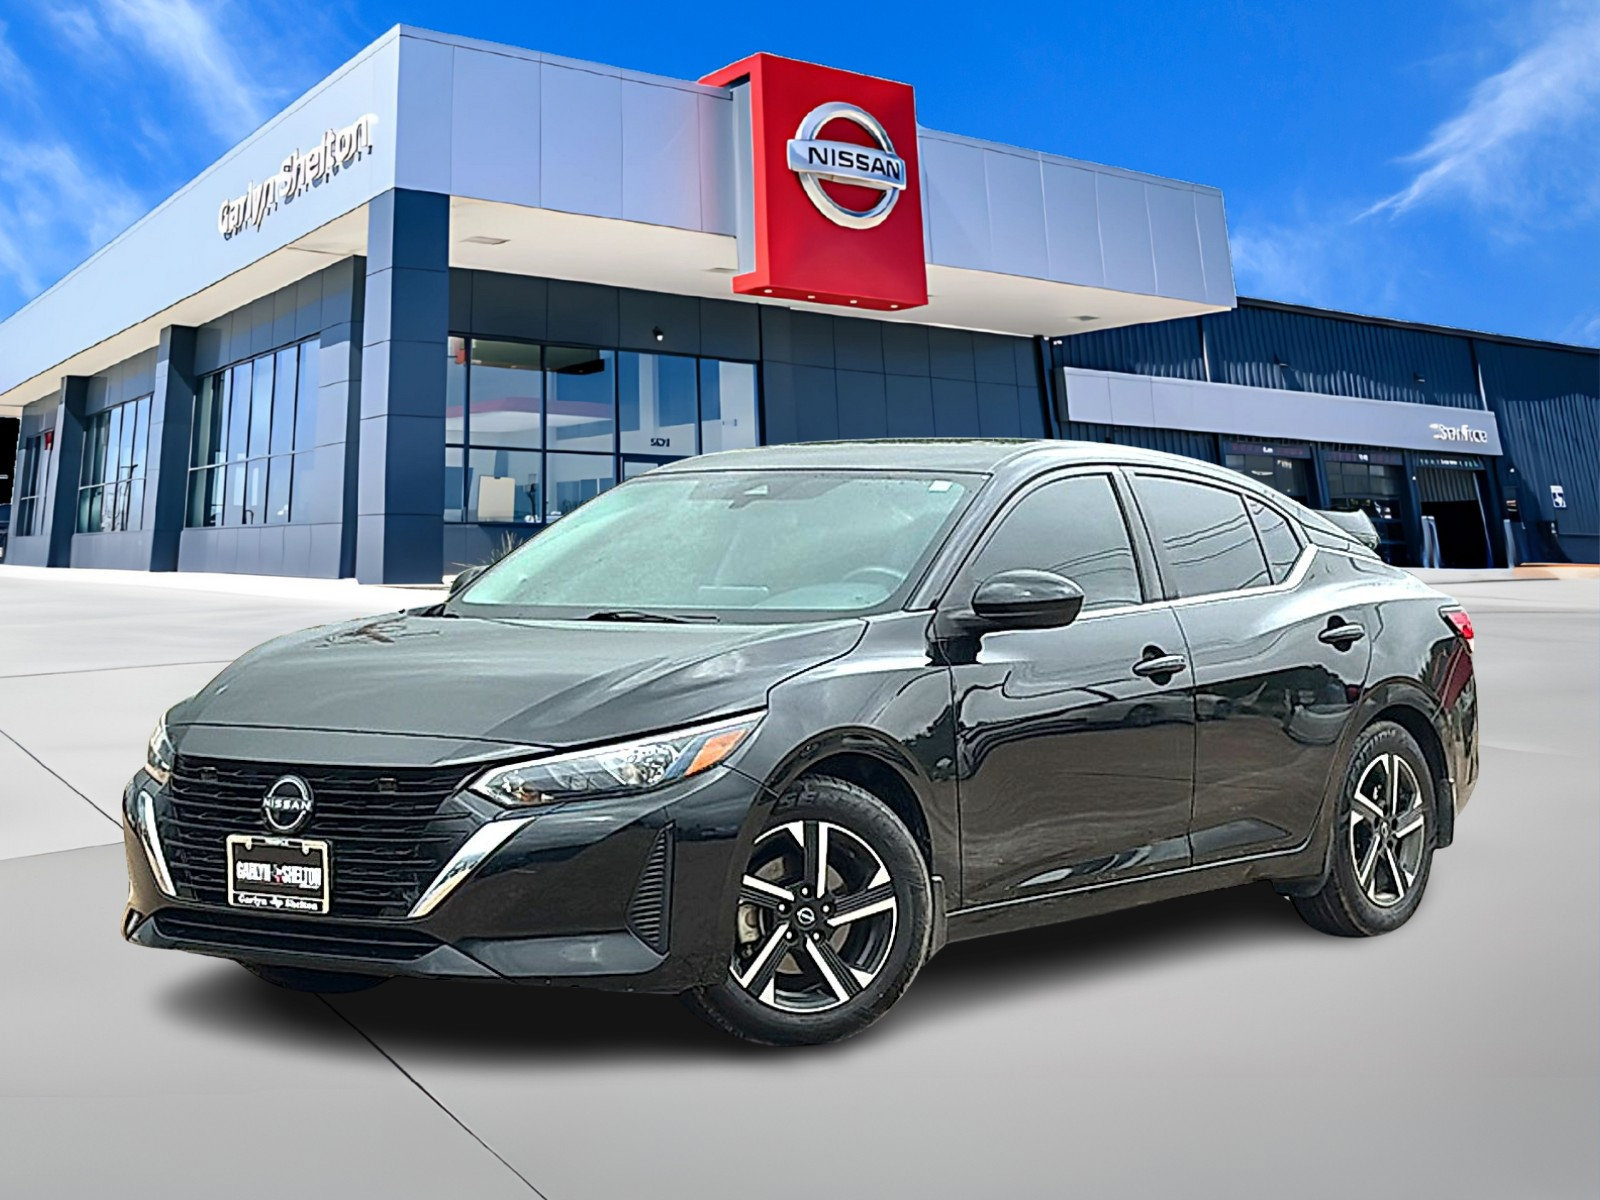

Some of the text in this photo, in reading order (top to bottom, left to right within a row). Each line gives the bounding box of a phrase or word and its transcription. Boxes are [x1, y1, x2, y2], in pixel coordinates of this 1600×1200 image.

[279, 114, 376, 201] Shelton
[808, 146, 901, 180] NISSAN
[262, 796, 313, 812] NISSAN
